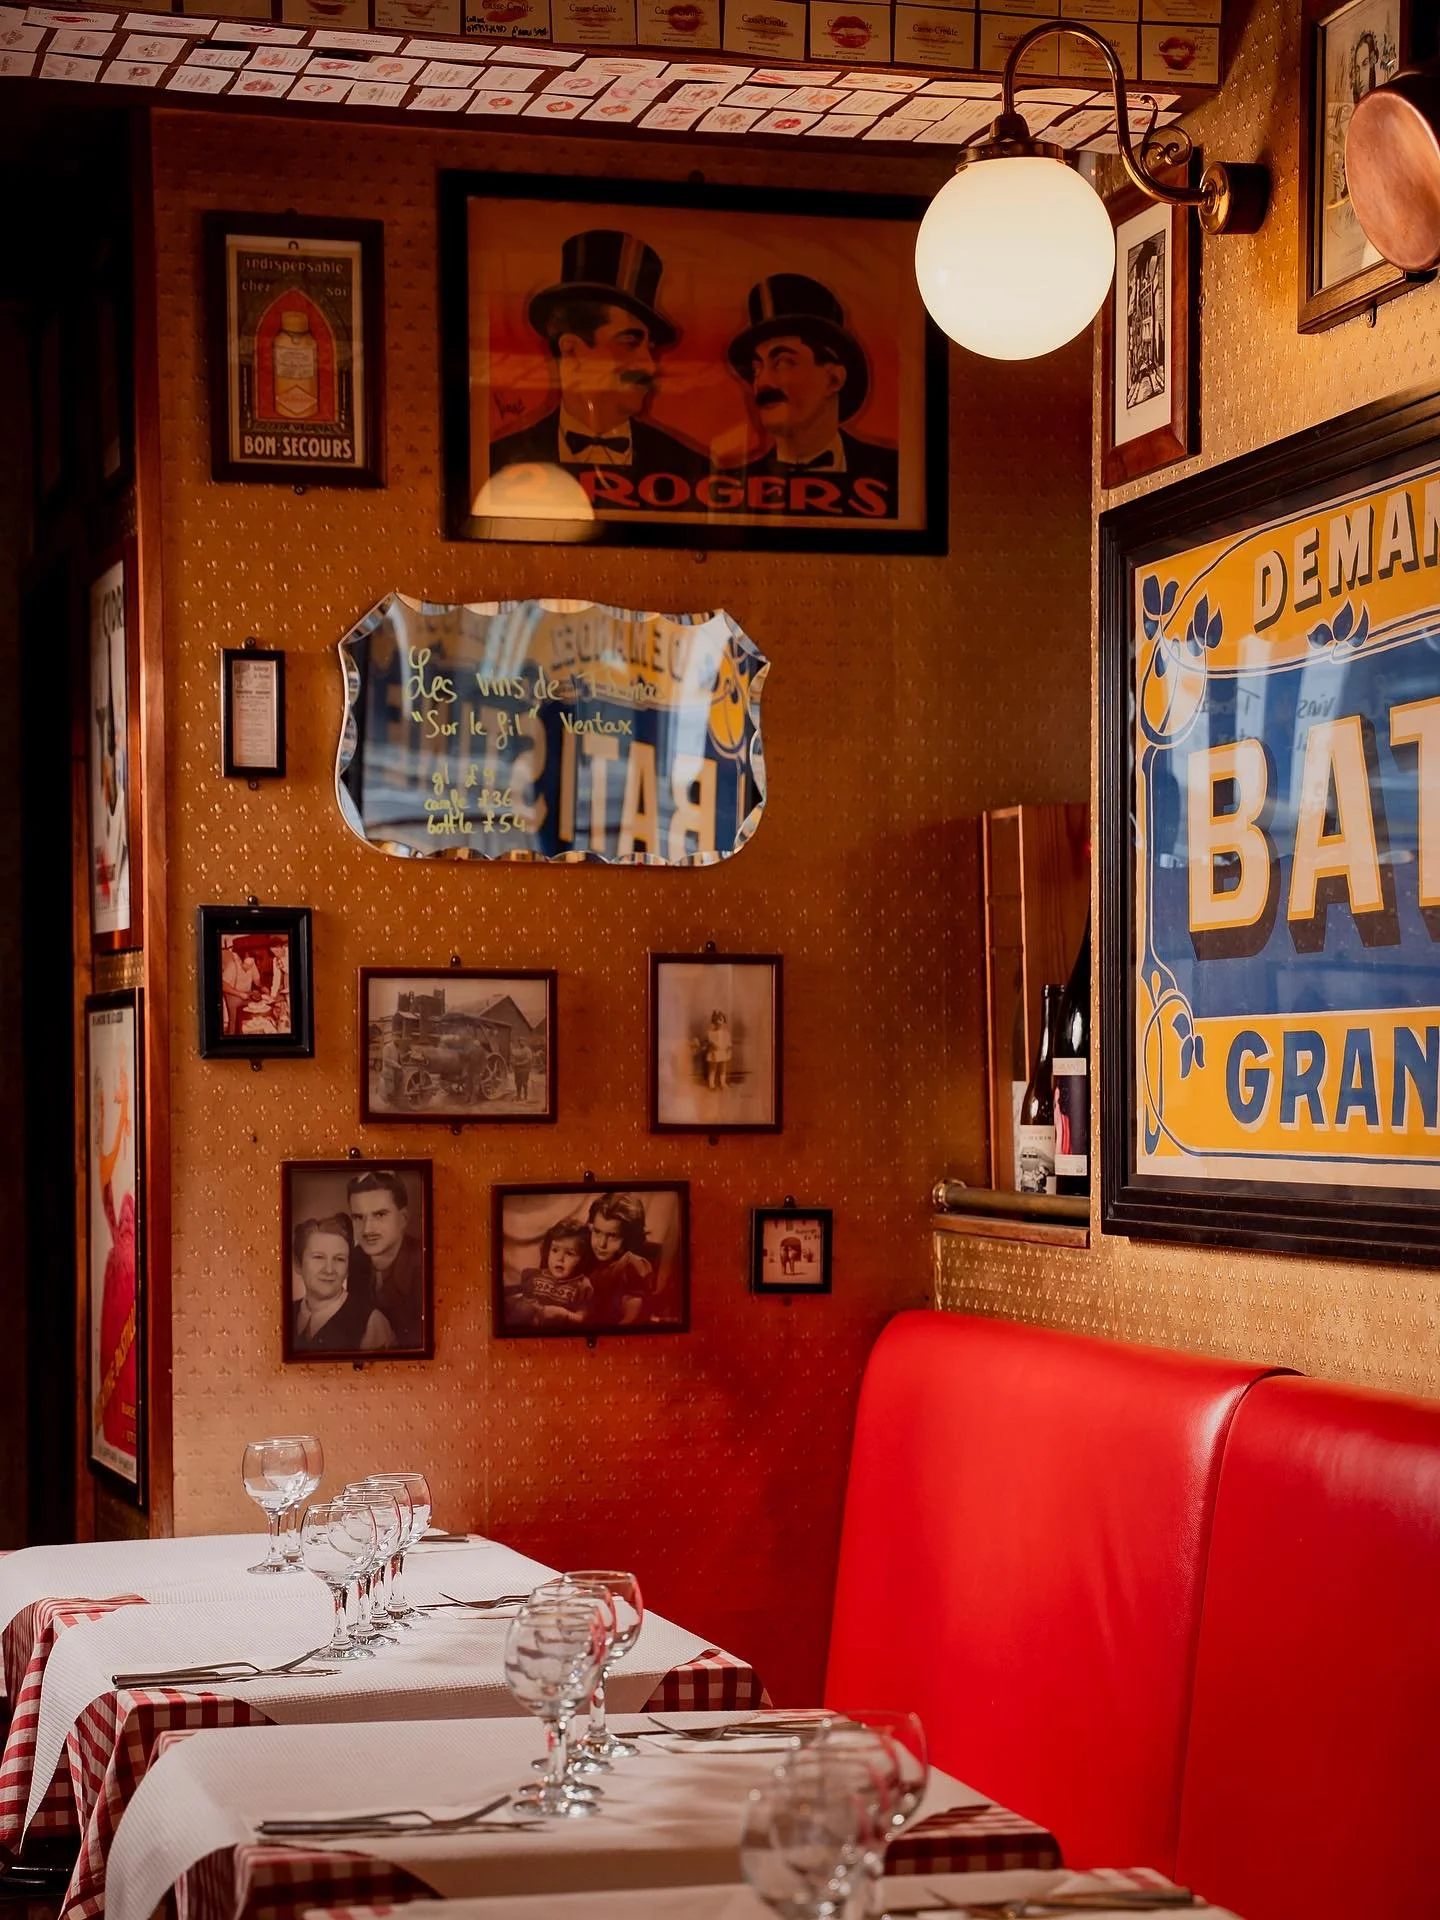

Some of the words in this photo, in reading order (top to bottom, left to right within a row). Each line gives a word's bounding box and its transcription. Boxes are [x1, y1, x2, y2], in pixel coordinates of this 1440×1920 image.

[281, 436, 352, 459] SECOURS
[579, 471, 890, 518] ROGERS
[404, 644, 458, 704] Les
[475, 669, 525, 700] vins
[533, 664, 563, 701] de
[469, 711, 489, 736] le
[427, 812, 477, 835] bottle
[482, 810, 527, 834] £54
[1187, 696, 1440, 960] BAT
[1225, 1025, 1440, 1136] GRAN
